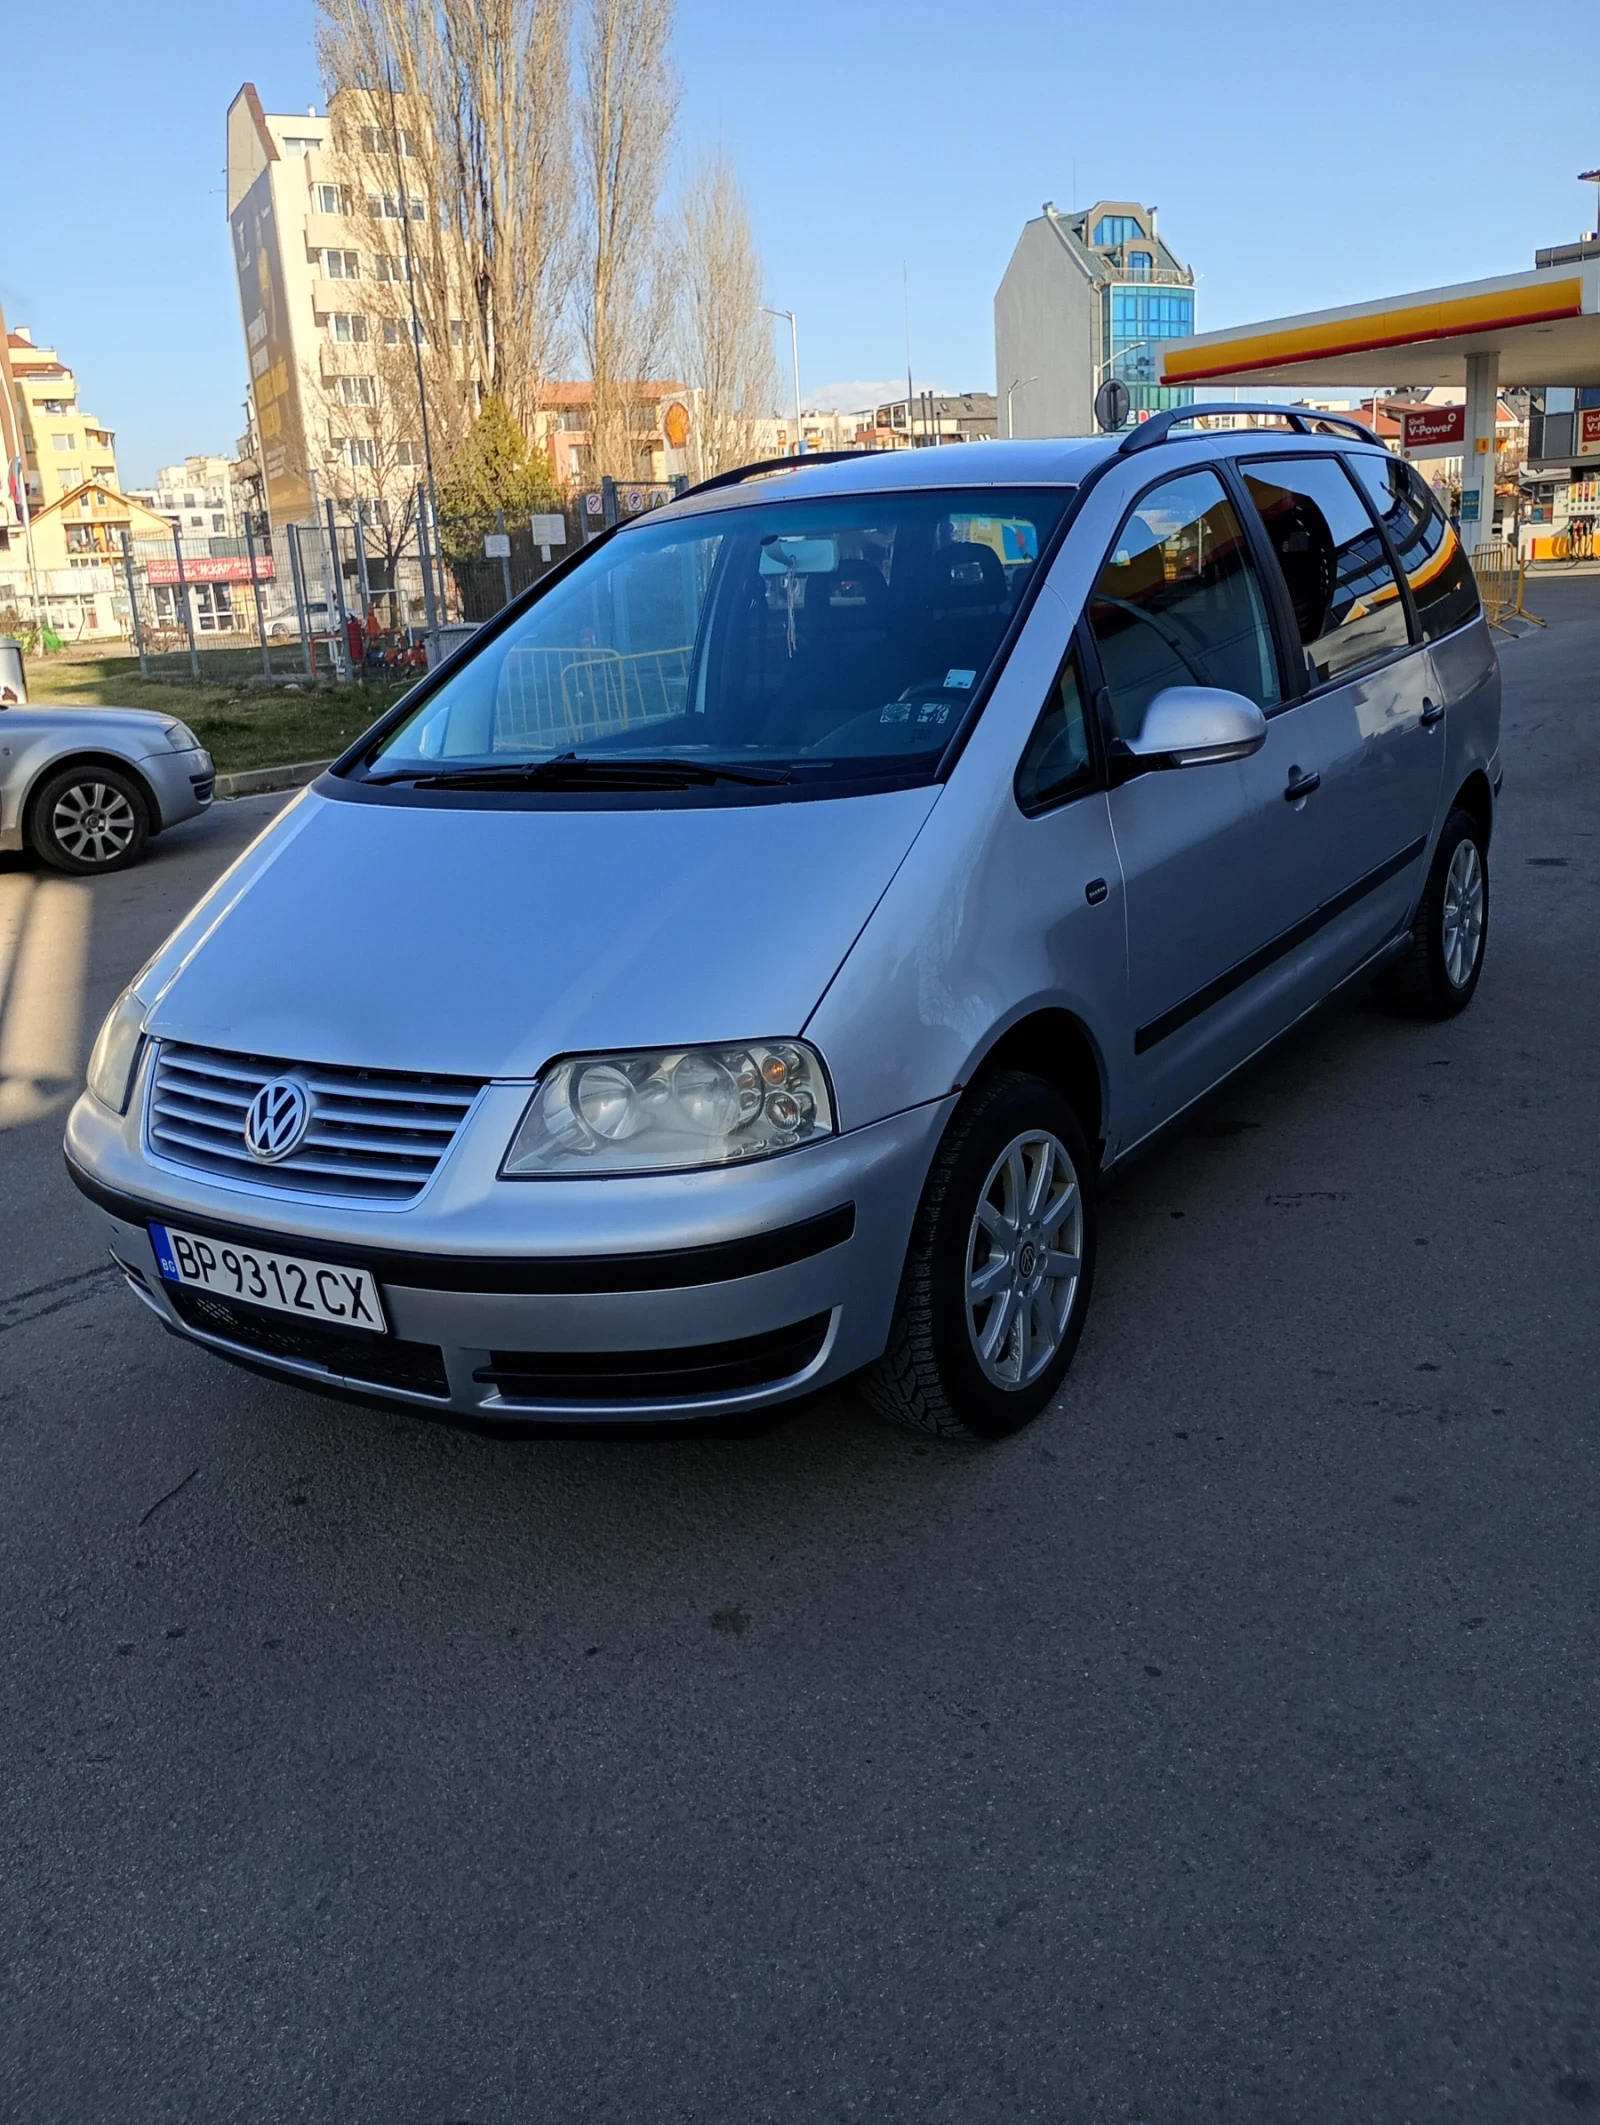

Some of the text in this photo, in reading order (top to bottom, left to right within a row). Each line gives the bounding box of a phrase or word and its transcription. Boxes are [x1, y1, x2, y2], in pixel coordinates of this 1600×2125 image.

[1408, 416, 1425, 426] Shell
[1408, 423, 1453, 437] V-Power
[160, 1257, 176, 1274] BG
